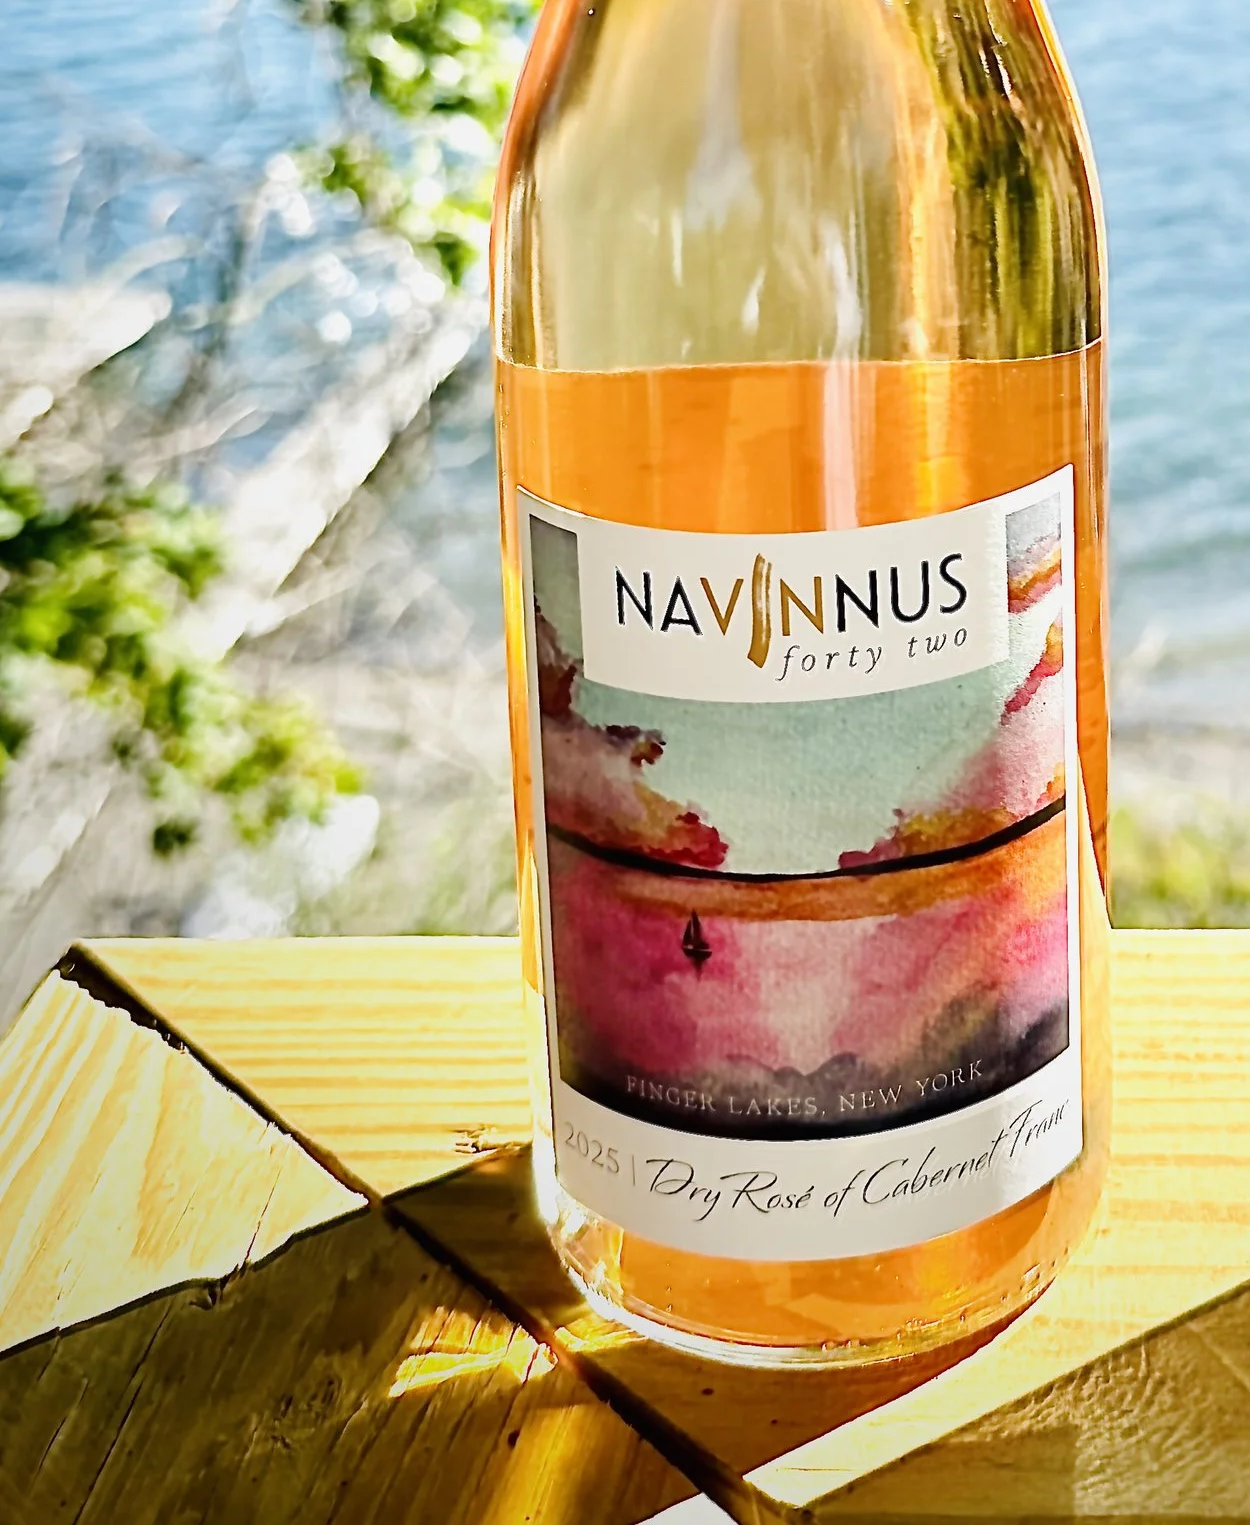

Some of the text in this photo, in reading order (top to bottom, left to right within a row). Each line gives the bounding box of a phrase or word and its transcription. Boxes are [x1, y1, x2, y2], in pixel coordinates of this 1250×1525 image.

[613, 551, 969, 669] NAVINNUS
[775, 626, 968, 682] forty two
[626, 1059, 985, 1119] FINGER LAKES, NEW YORK
[563, 1120, 621, 1175] 2025
[646, 1158, 722, 1222] Dry
[721, 1171, 813, 1214] Rosé
[823, 1169, 867, 1218] of
[862, 1127, 1006, 1205] Cabernet
